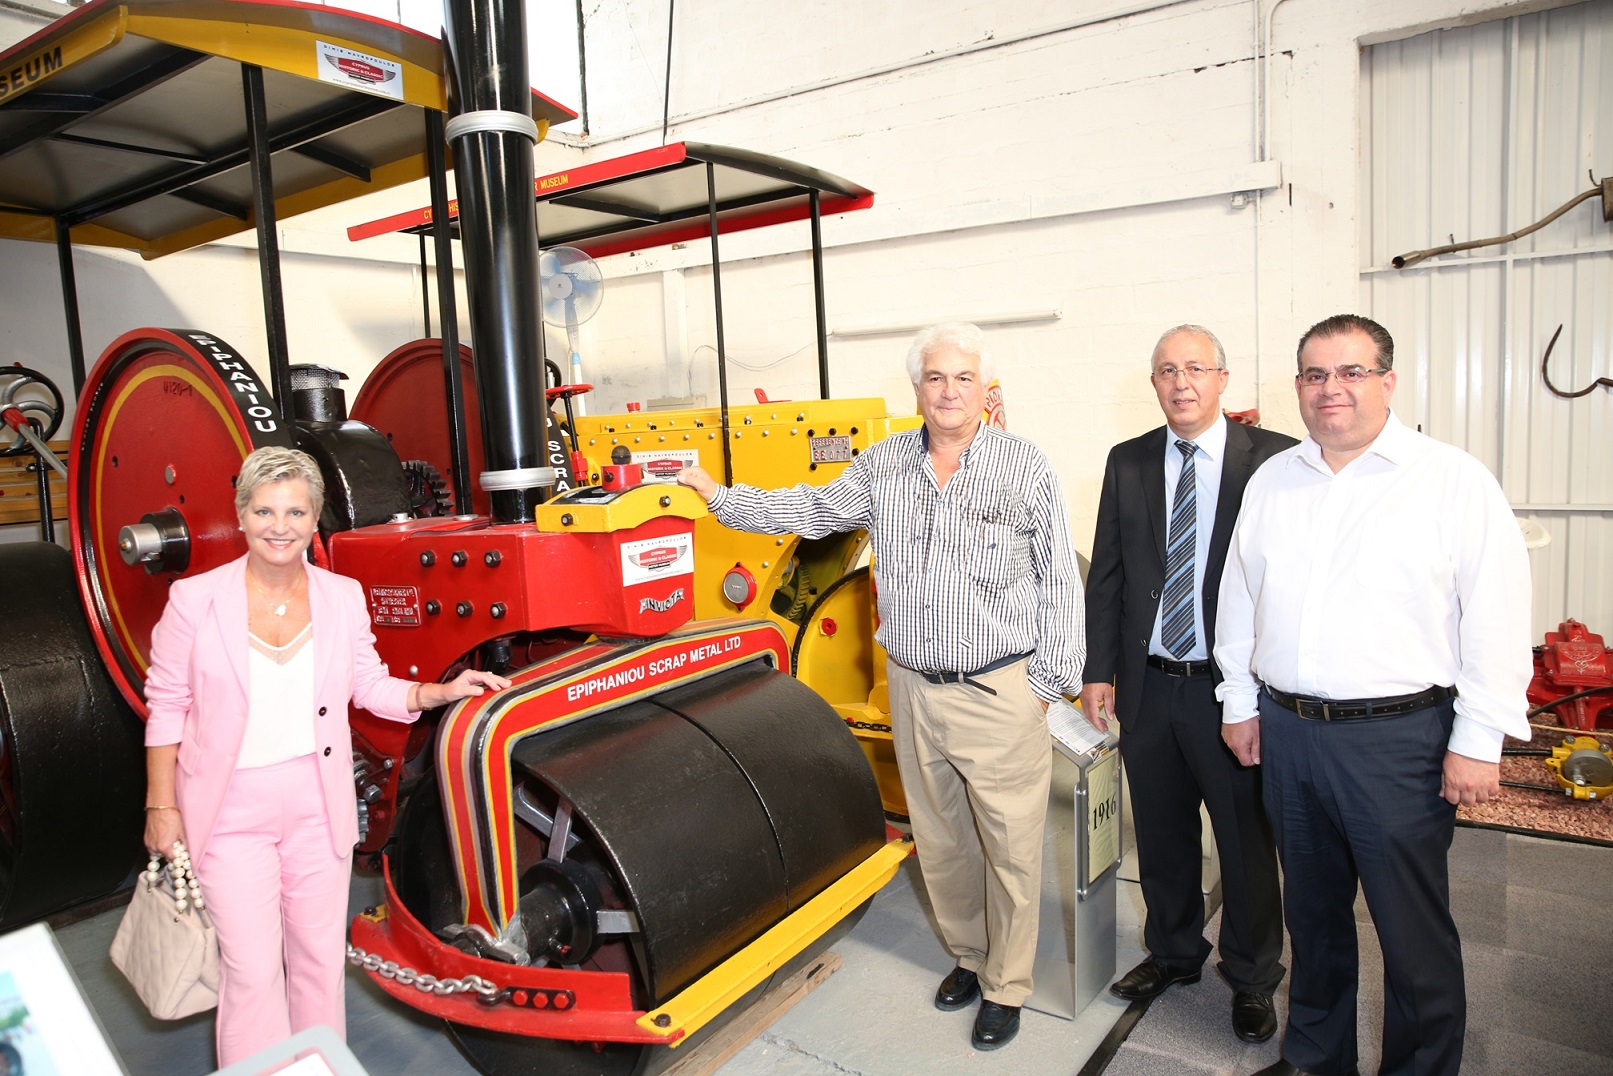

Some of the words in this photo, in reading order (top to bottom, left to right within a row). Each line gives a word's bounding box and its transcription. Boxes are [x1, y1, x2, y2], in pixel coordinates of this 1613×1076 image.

[351, 62, 371, 70] CYPRUS
[364, 70, 383, 79] CLASSIC
[540, 174, 568, 189] MUSEUM
[567, 665, 645, 701] EPIPHANIOU
[649, 653, 686, 676] SCRAP
[689, 642, 722, 663] METAL
[724, 635, 741, 652] LTD
[1093, 791, 1116, 830] 1916
